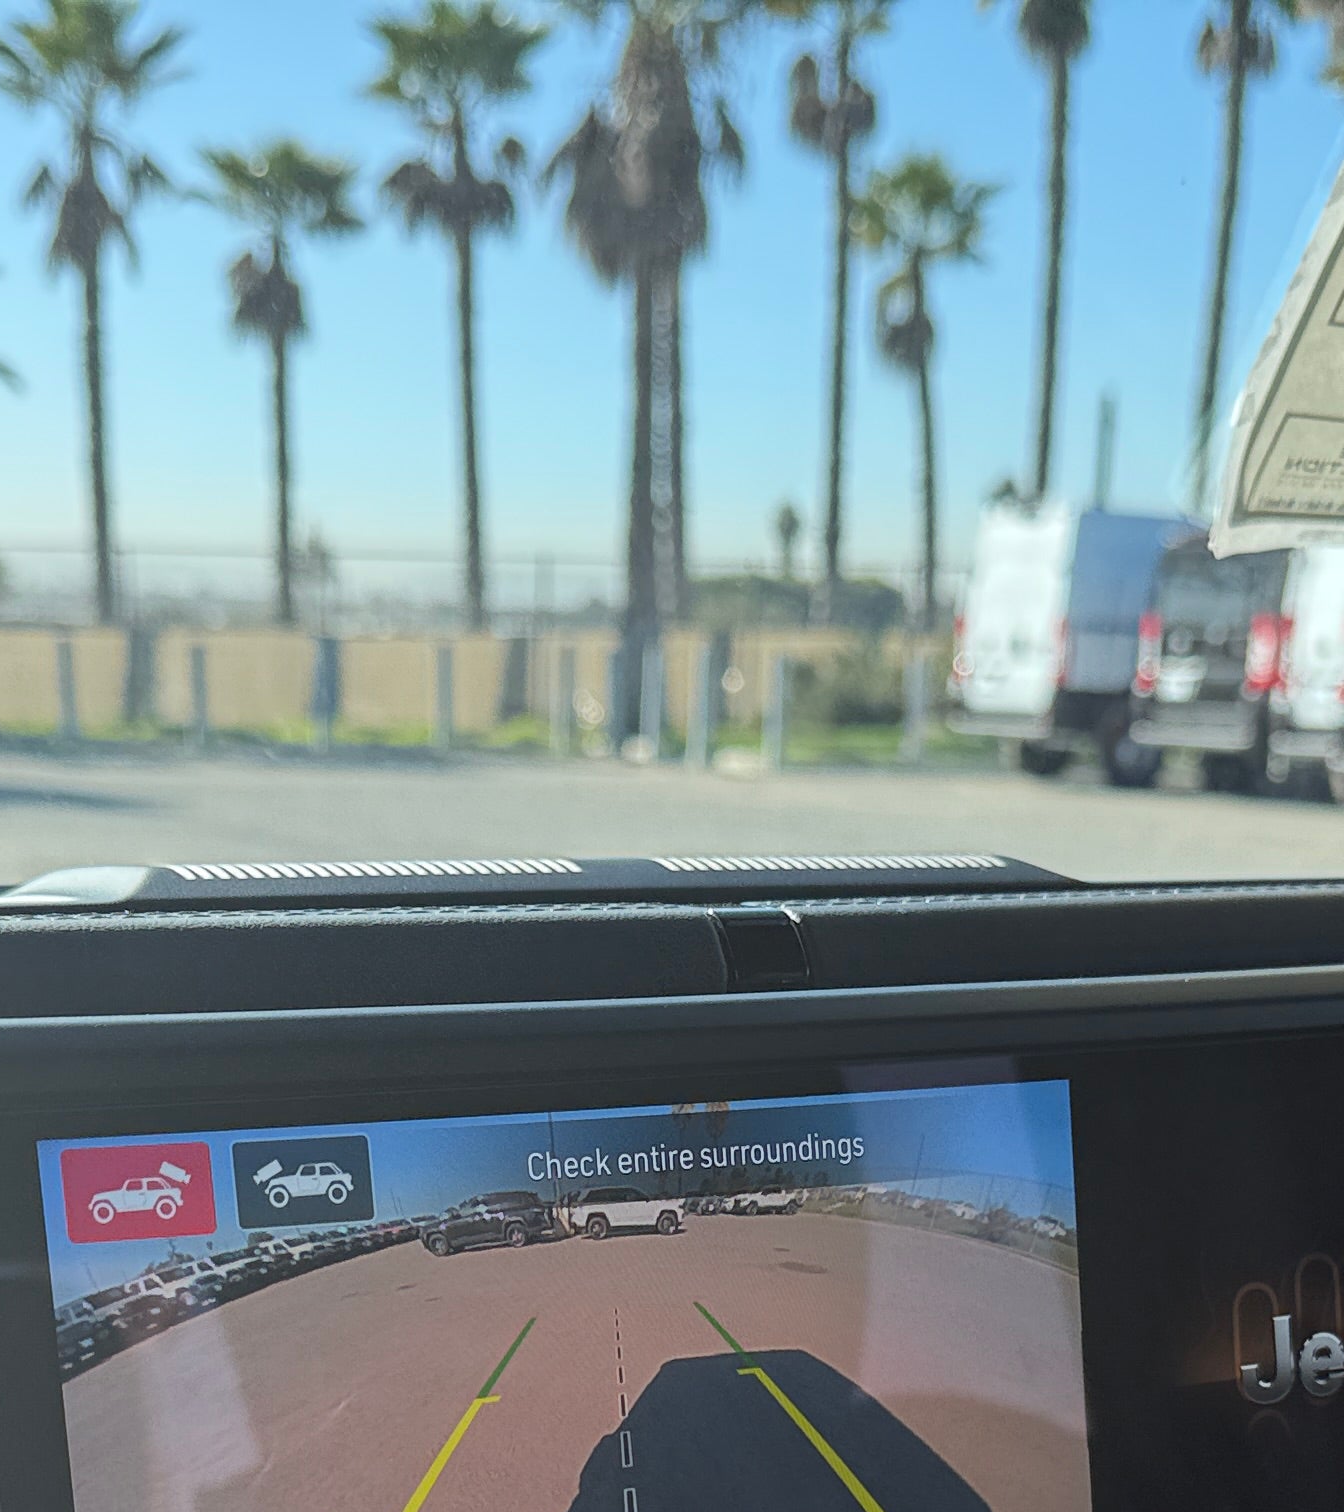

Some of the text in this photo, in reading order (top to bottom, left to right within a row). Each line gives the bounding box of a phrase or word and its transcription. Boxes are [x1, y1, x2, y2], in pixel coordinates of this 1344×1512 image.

[527, 1132, 866, 1183] Check entire surroundings
